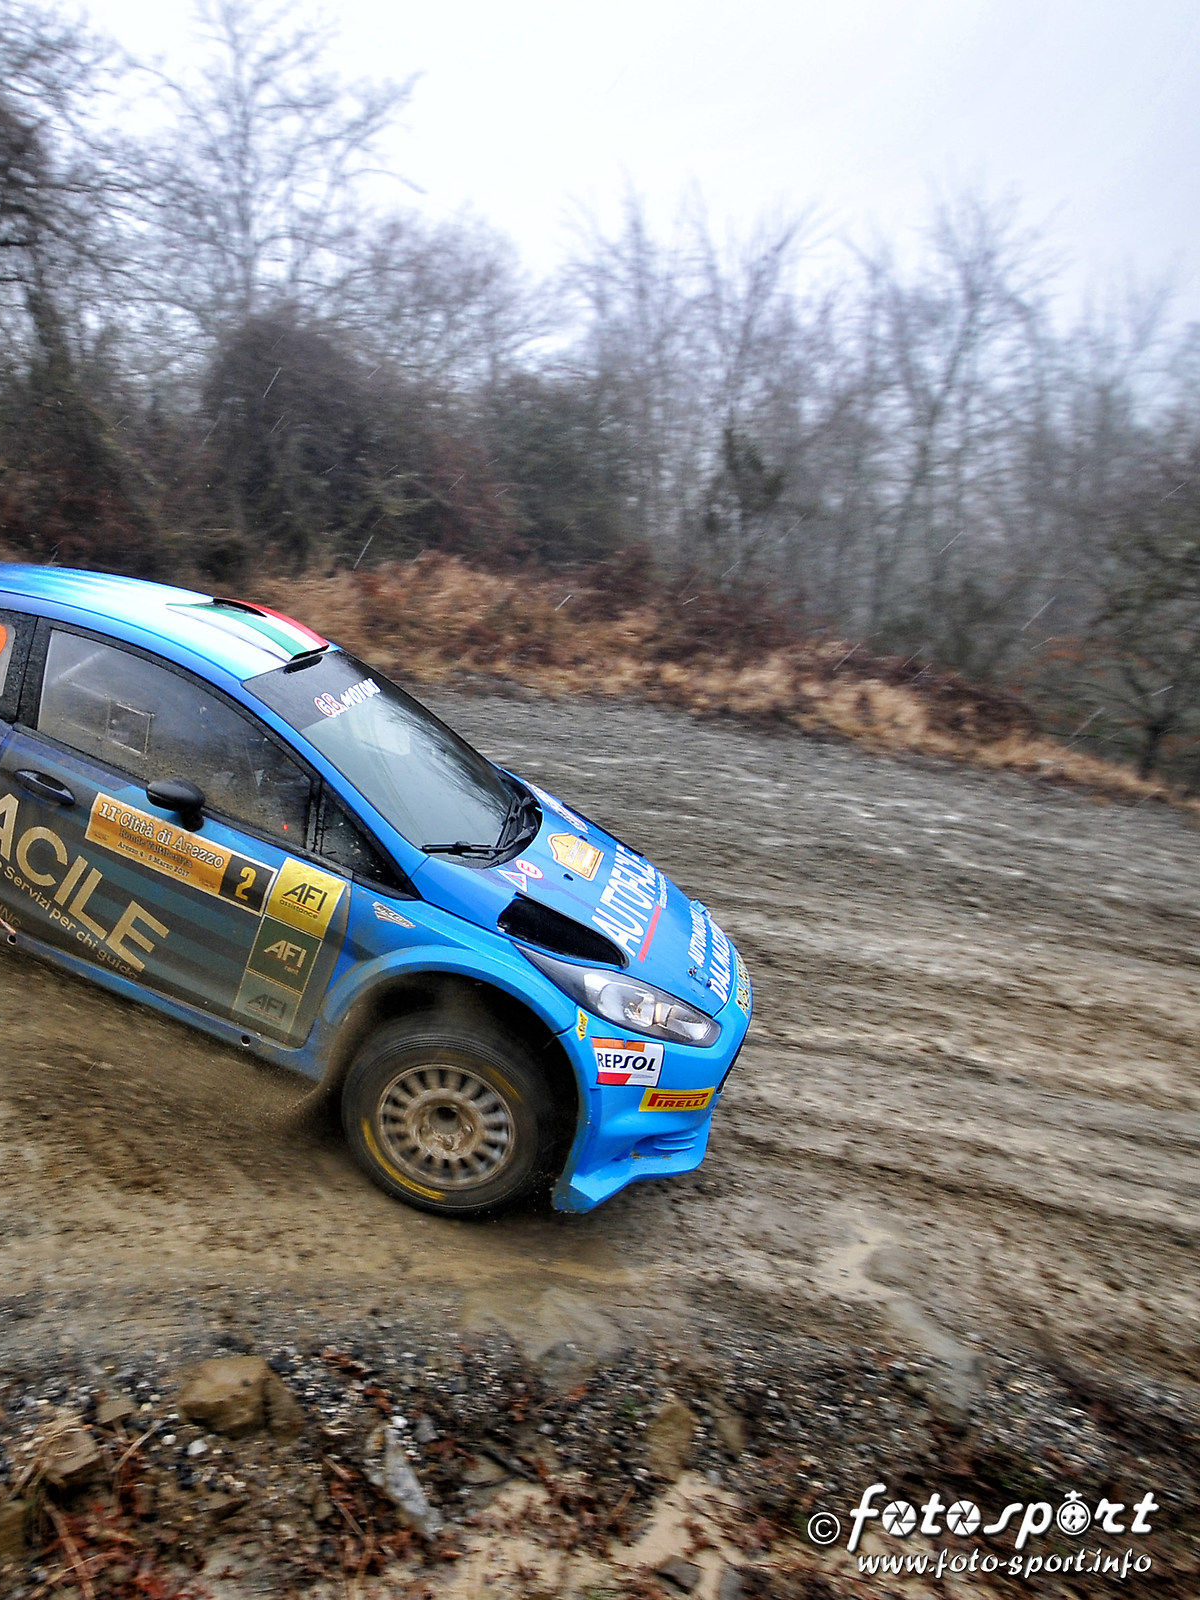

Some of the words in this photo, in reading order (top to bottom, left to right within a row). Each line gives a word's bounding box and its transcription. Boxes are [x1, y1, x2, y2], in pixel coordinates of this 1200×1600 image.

[119, 811, 154, 839] Città
[156, 828, 172, 847] di
[172, 836, 225, 869] Arezzo
[117, 840, 139, 855] Arezzo
[173, 862, 190, 878] 2017
[234, 866, 257, 901] 2
[282, 882, 328, 911] AFI
[3, 865, 51, 911] Servizi
[49, 906, 77, 930] per
[76, 929, 99, 949] chi
[279, 899, 319, 920] assistance
[263, 939, 307, 968] AFI
[597, 1052, 656, 1072] REPSOL
[647, 1092, 709, 1108] PIRELLI
